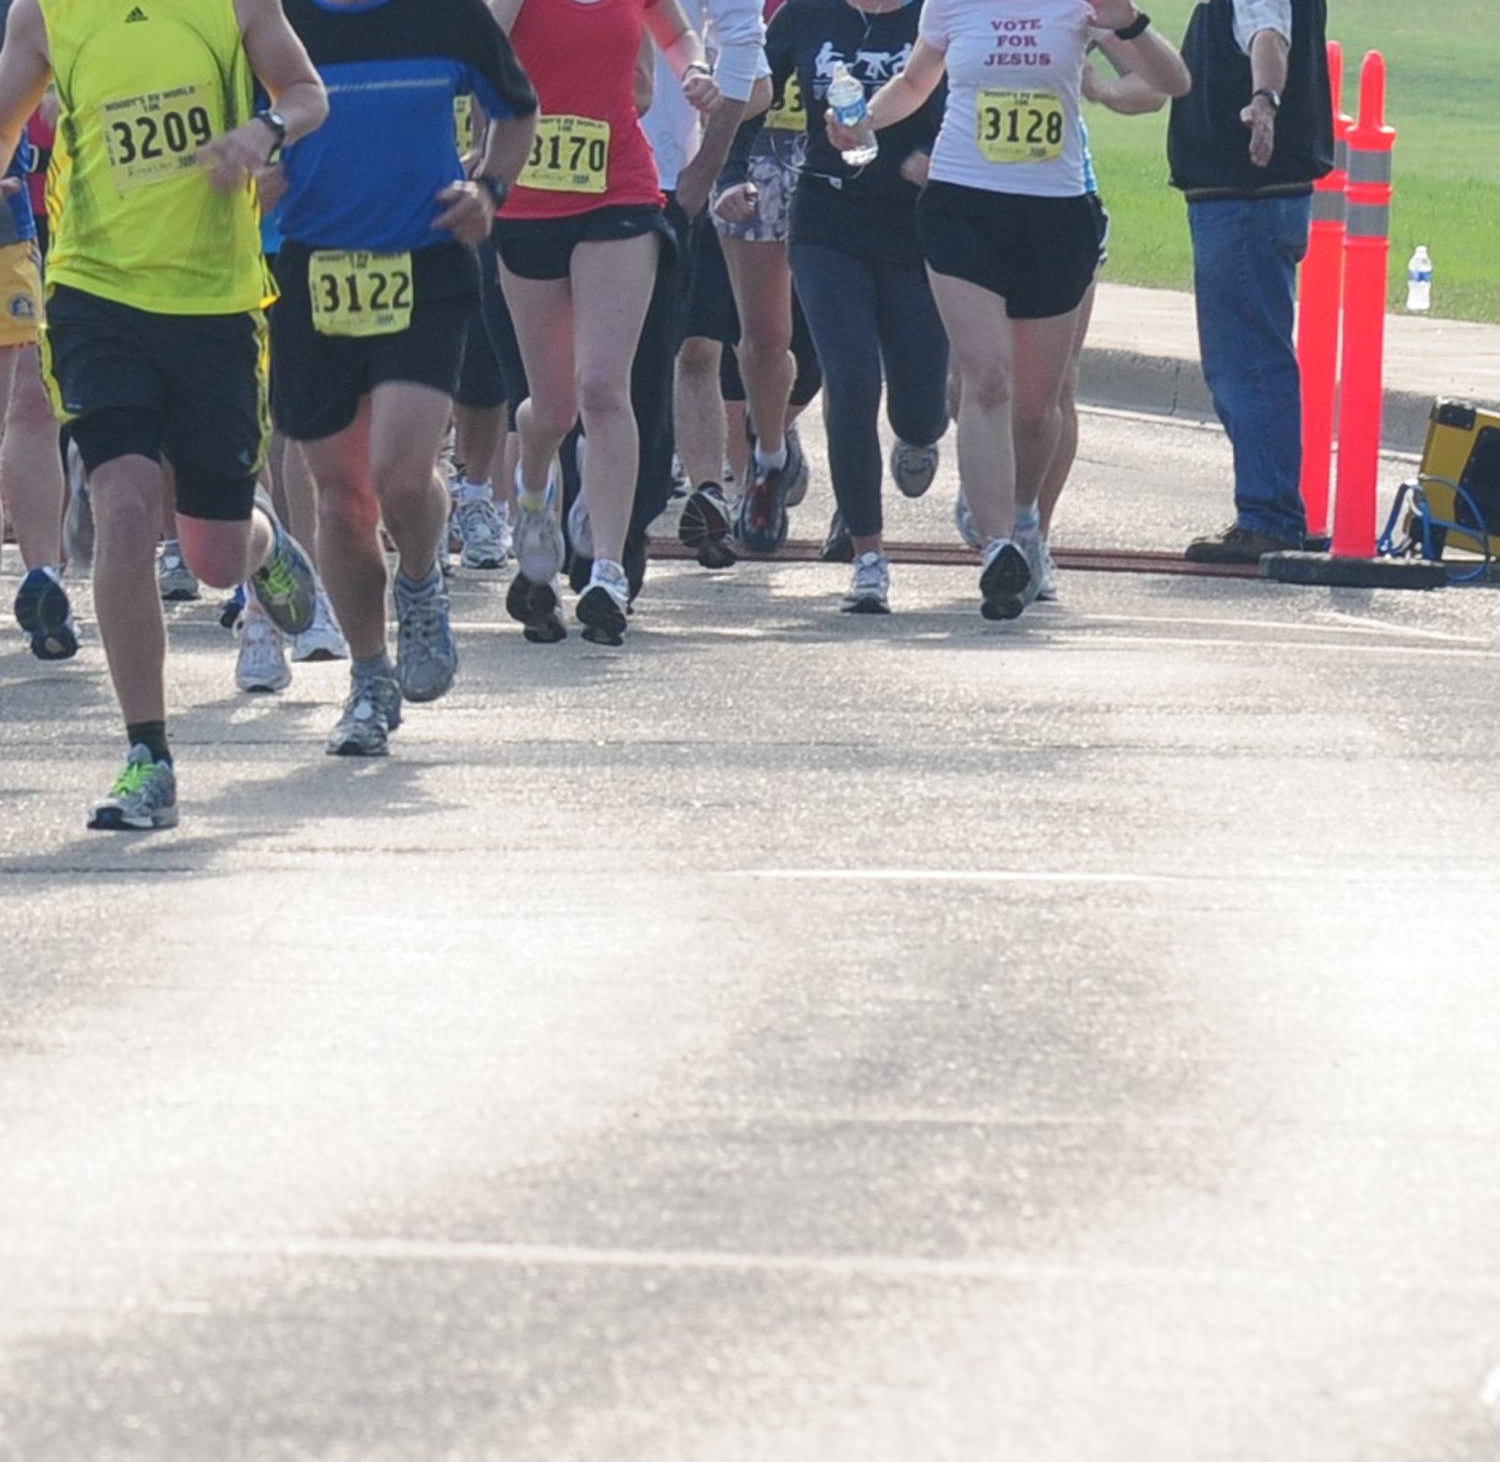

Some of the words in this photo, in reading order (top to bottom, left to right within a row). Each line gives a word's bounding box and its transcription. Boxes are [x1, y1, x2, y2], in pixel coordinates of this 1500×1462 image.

[991, 19, 1041, 32] VOTE
[996, 35, 1037, 48] FOR
[984, 52, 1051, 67] JESUS
[111, 106, 212, 165] 3209
[984, 106, 1062, 145] 3128
[528, 135, 606, 172] 3170
[319, 271, 410, 314] 3122
